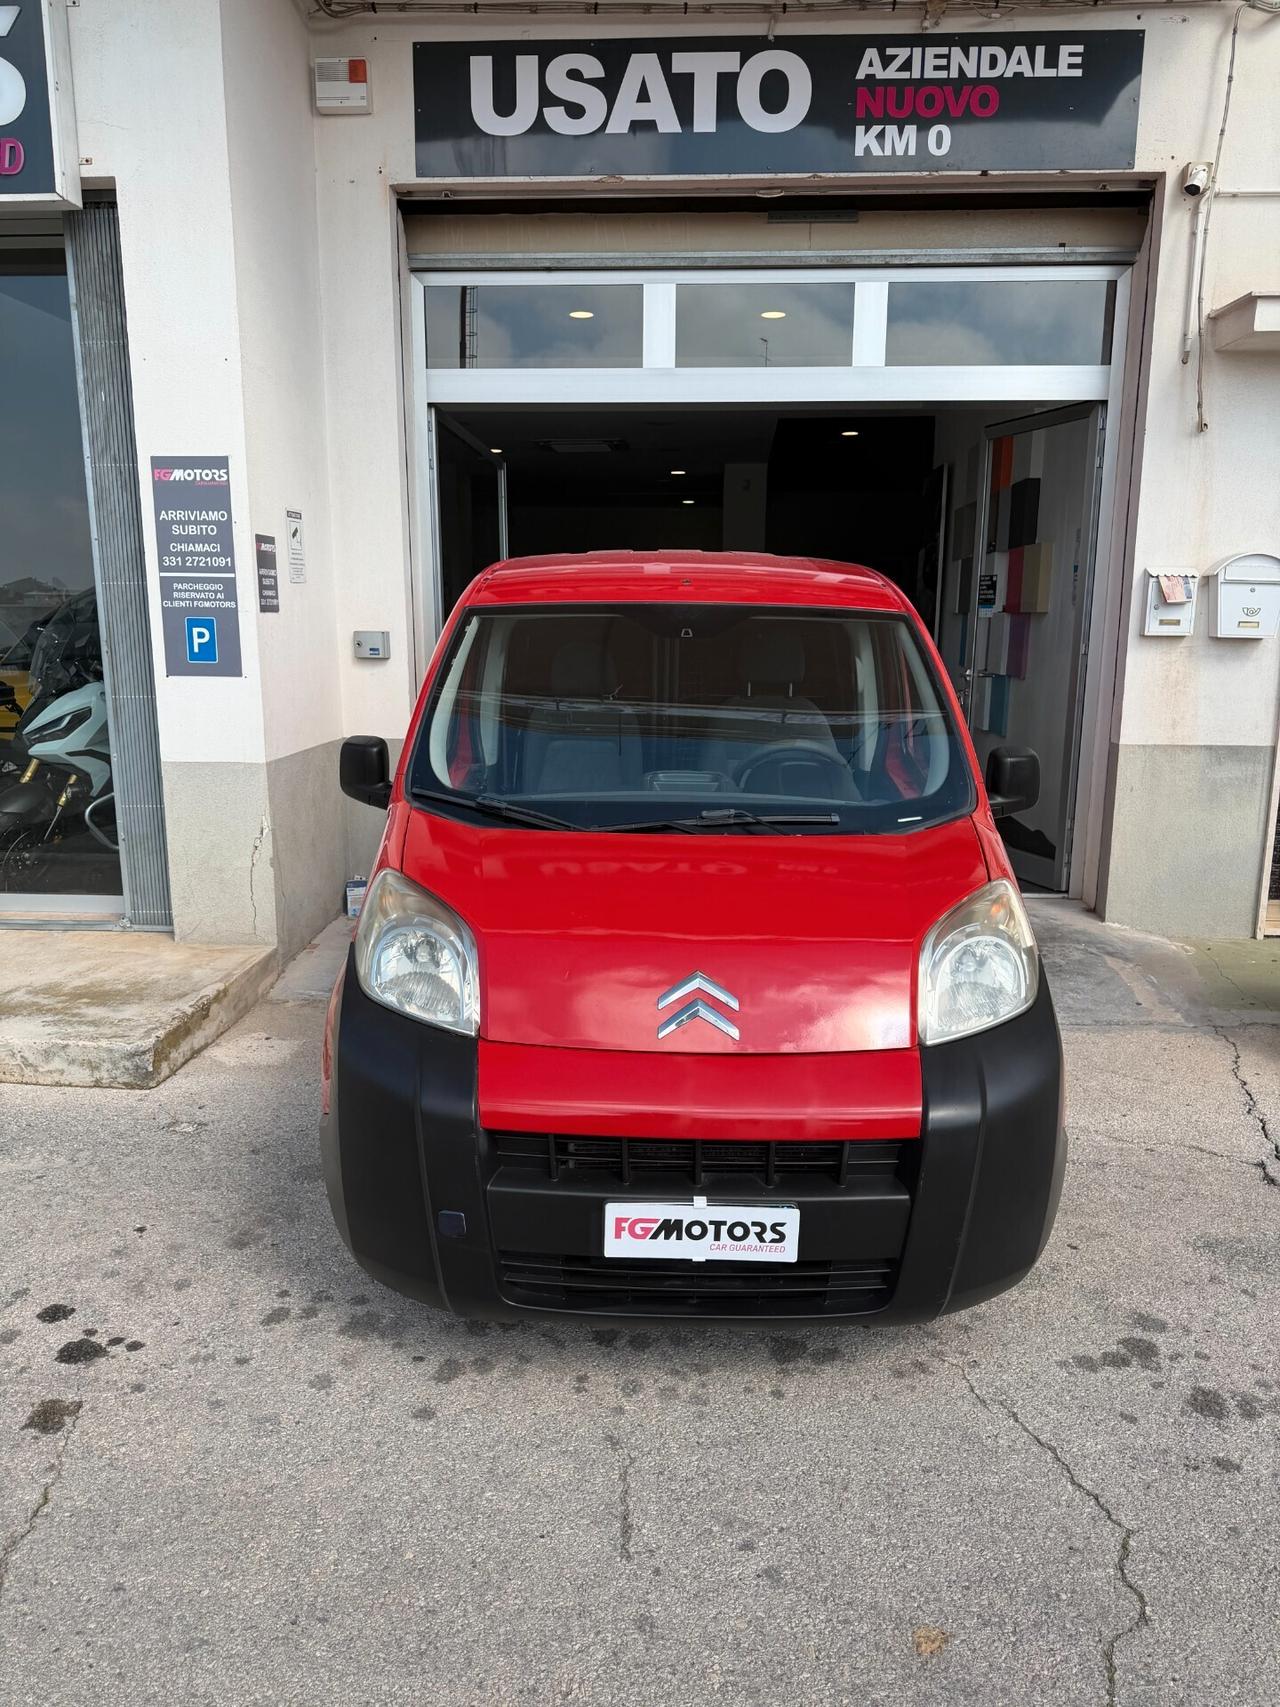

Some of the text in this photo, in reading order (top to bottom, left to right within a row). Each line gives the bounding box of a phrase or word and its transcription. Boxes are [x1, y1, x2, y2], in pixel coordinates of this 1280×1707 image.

[855, 44, 1084, 80] AZIENDALE
[470, 49, 812, 137] USATO
[855, 84, 1000, 118] NUOVO
[854, 124, 917, 156] KM
[159, 510, 228, 521] ARRIVIAMO
[171, 524, 217, 535] SUBITO
[169, 543, 220, 552] CHIAMACI
[162, 556, 232, 567] 331 2721091
[173, 583, 224, 591] PARCHEGGIO
[216, 592, 225, 600] AI
[193, 601, 236, 609] FGMOTORS
[192, 627, 211, 653] P
[614, 1217, 787, 1244] FGMOTORS
[709, 1243, 786, 1254] CAR GUARANTEED
